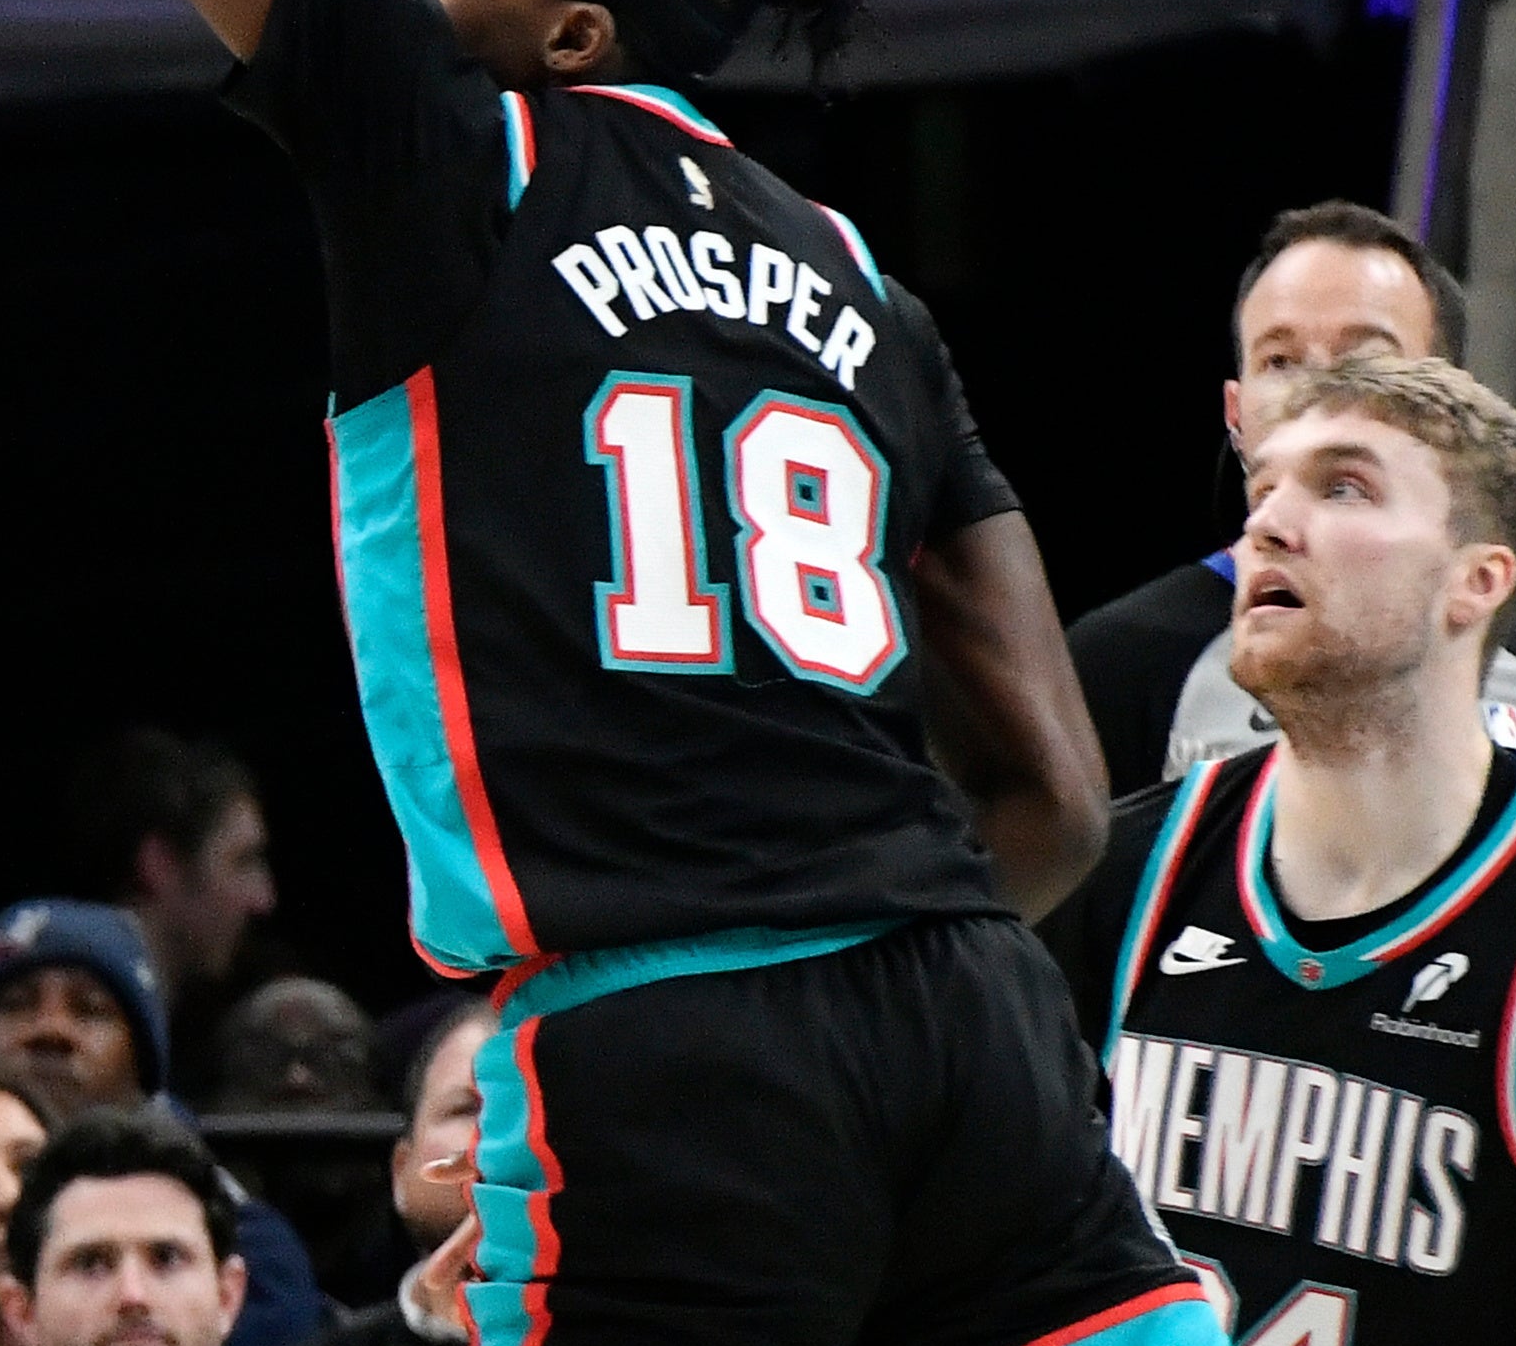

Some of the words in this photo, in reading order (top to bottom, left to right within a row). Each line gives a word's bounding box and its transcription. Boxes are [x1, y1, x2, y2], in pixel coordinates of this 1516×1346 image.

[551, 225, 876, 391] PROSPER
[582, 369, 910, 697] 18
[1108, 1031, 1480, 1277] MEMPHIS
